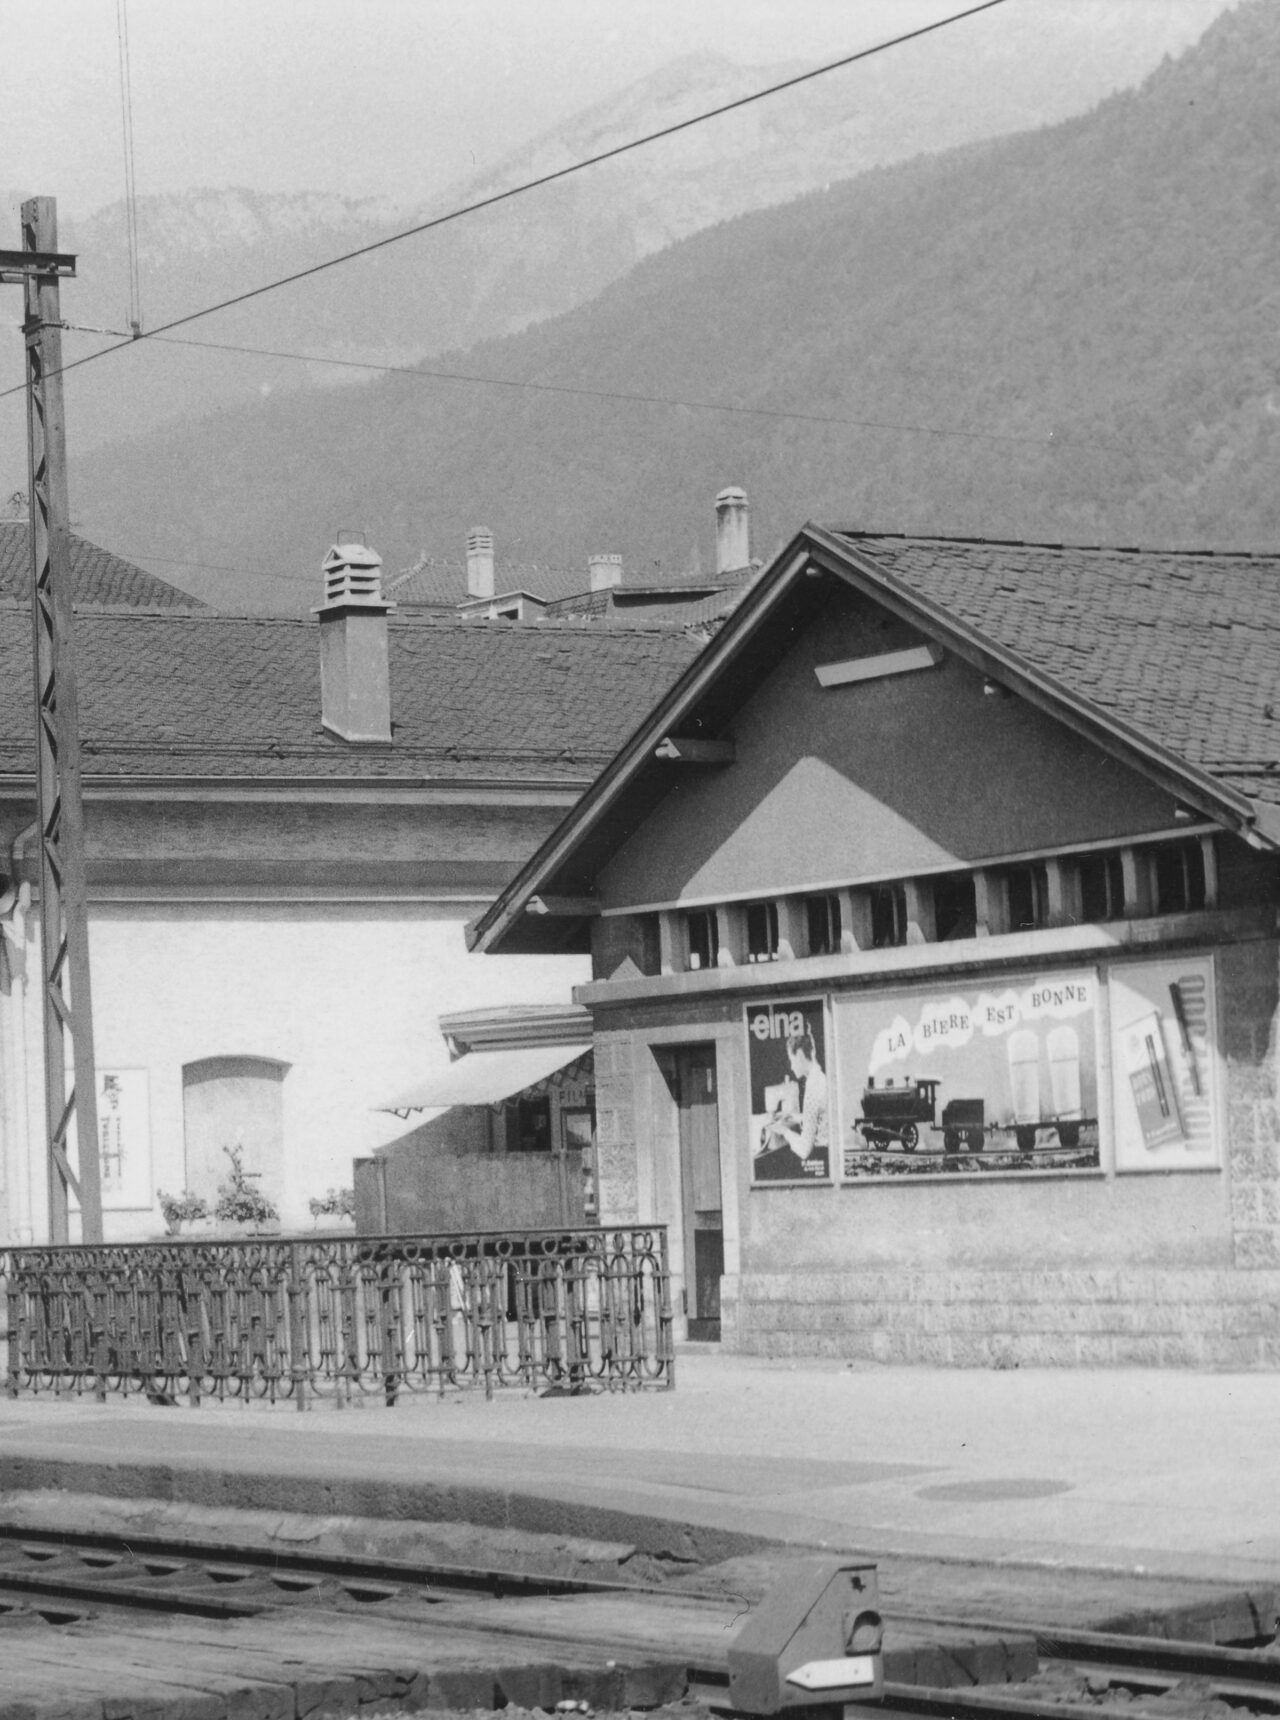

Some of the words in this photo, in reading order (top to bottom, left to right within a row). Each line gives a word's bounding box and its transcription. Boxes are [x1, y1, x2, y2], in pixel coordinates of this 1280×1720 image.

[749, 1003, 806, 1041] elna
[887, 1032, 907, 1053] LA
[922, 1013, 970, 1039] BIERE
[985, 1004, 1015, 1025] EST
[1031, 984, 1088, 1008] BONNE
